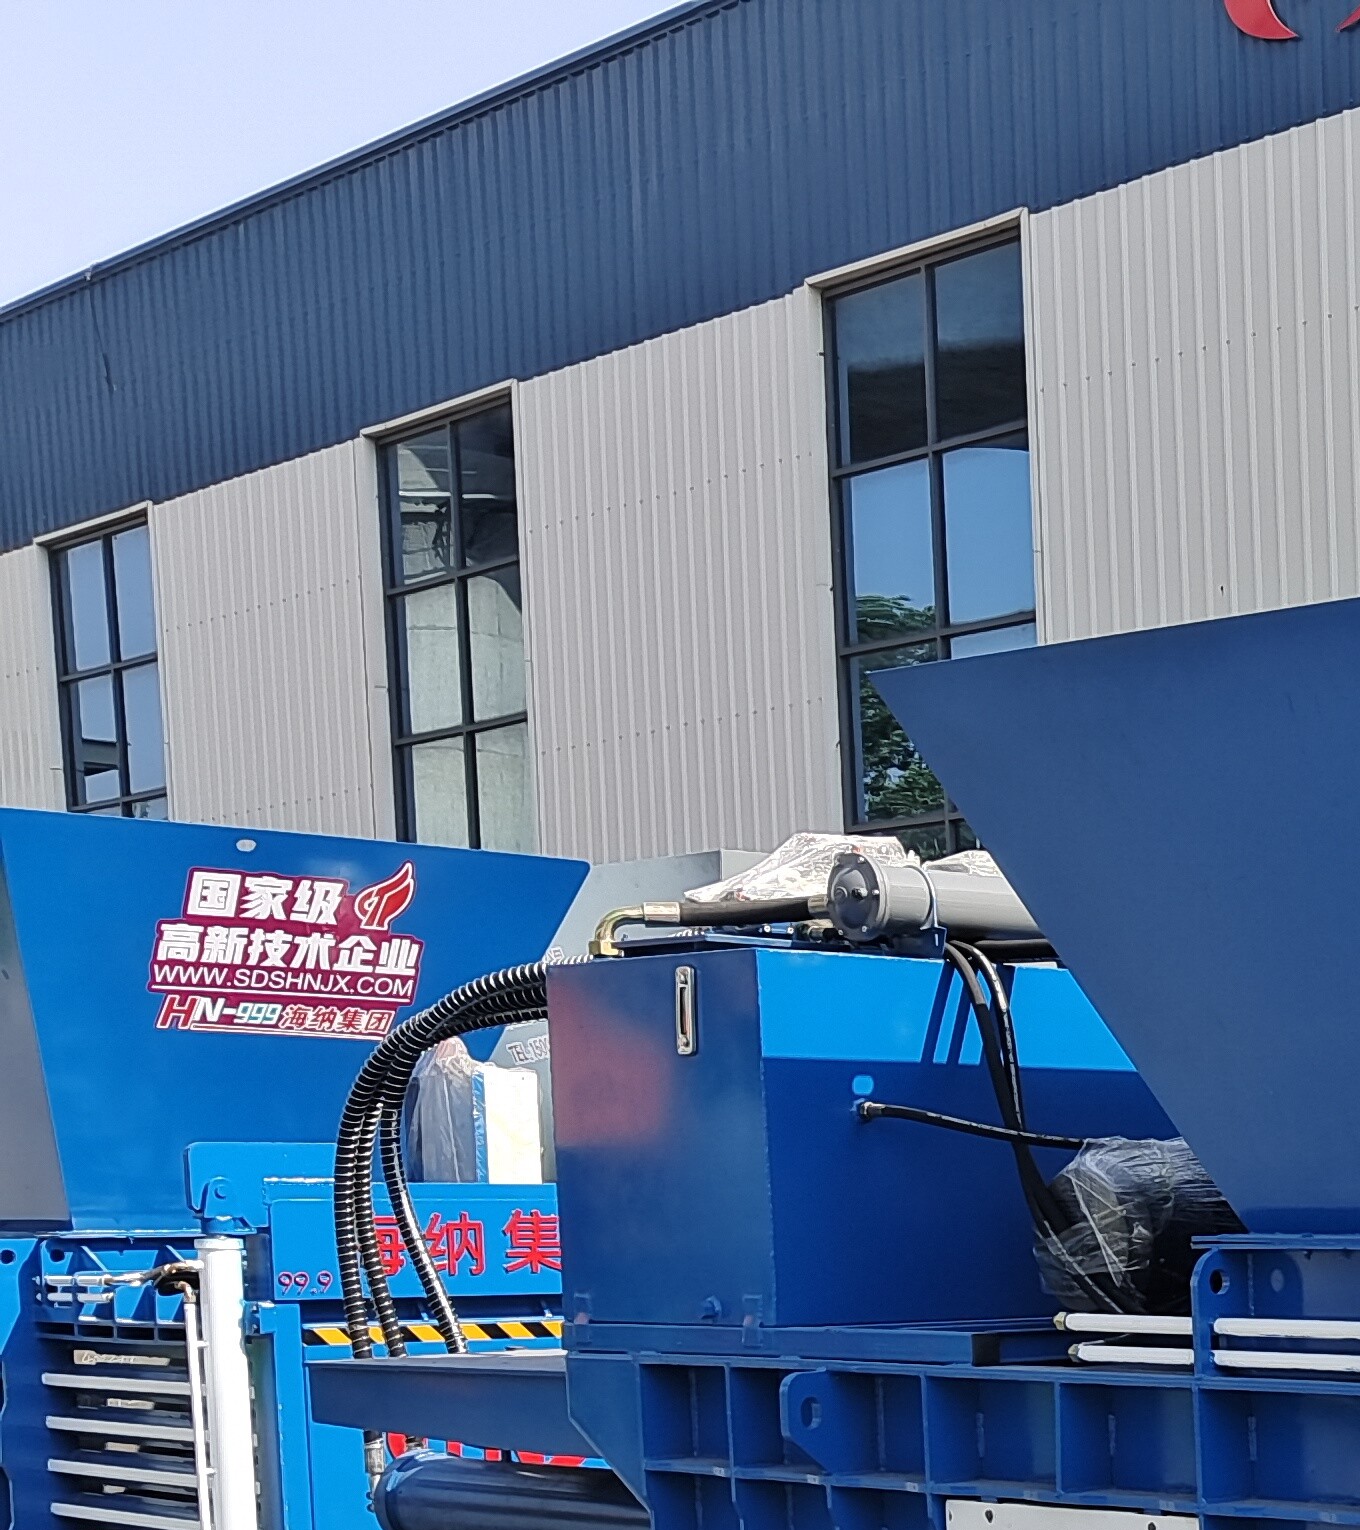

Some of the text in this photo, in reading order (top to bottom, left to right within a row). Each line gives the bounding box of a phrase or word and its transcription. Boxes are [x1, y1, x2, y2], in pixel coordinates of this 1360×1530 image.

[187, 871, 346, 926] 国家级
[157, 922, 420, 976] 高新技术企业
[153, 963, 415, 997] WWW.SDSHNJX.COM
